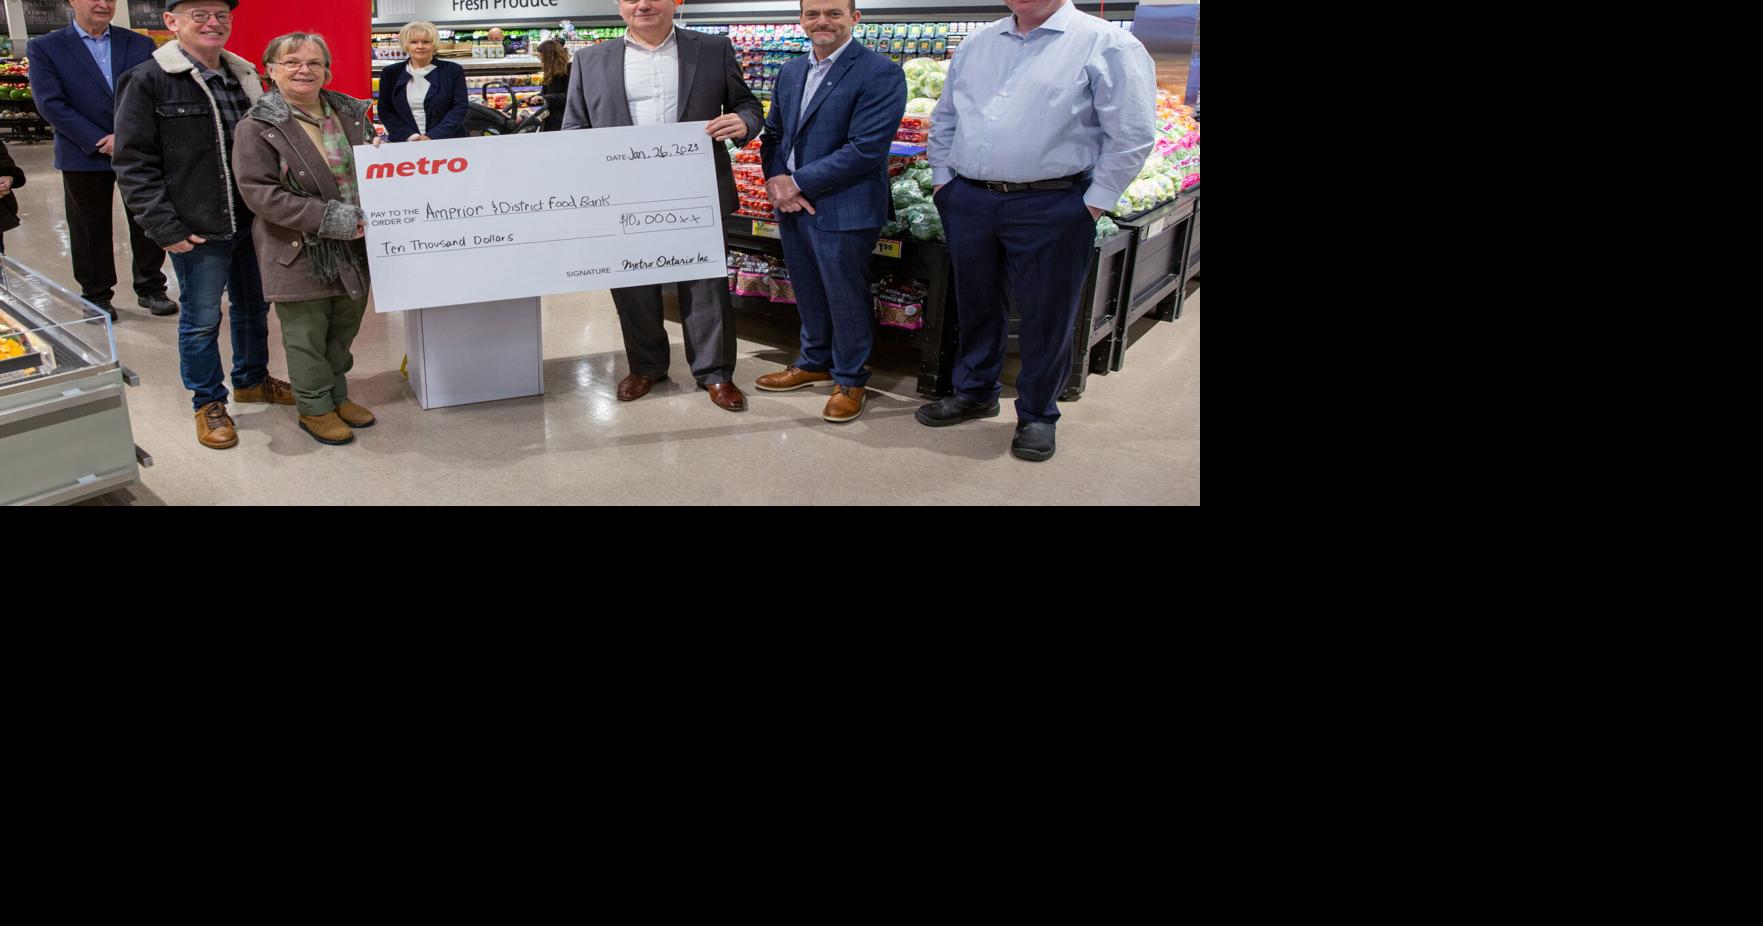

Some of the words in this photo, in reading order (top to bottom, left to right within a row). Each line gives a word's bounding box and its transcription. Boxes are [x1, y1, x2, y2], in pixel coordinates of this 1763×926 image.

[672, 143, 699, 155] 2023
[366, 157, 468, 179] metro
[371, 210, 386, 218] PAY
[389, 209, 401, 217] TO
[403, 208, 420, 216] THE
[371, 217, 402, 227] ORDER
[381, 241, 406, 255] Ten
[410, 236, 466, 251] Thousand
[473, 233, 514, 246] Dollars
[656, 255, 694, 268] Ontario
[566, 267, 611, 278] SIGNATURE
